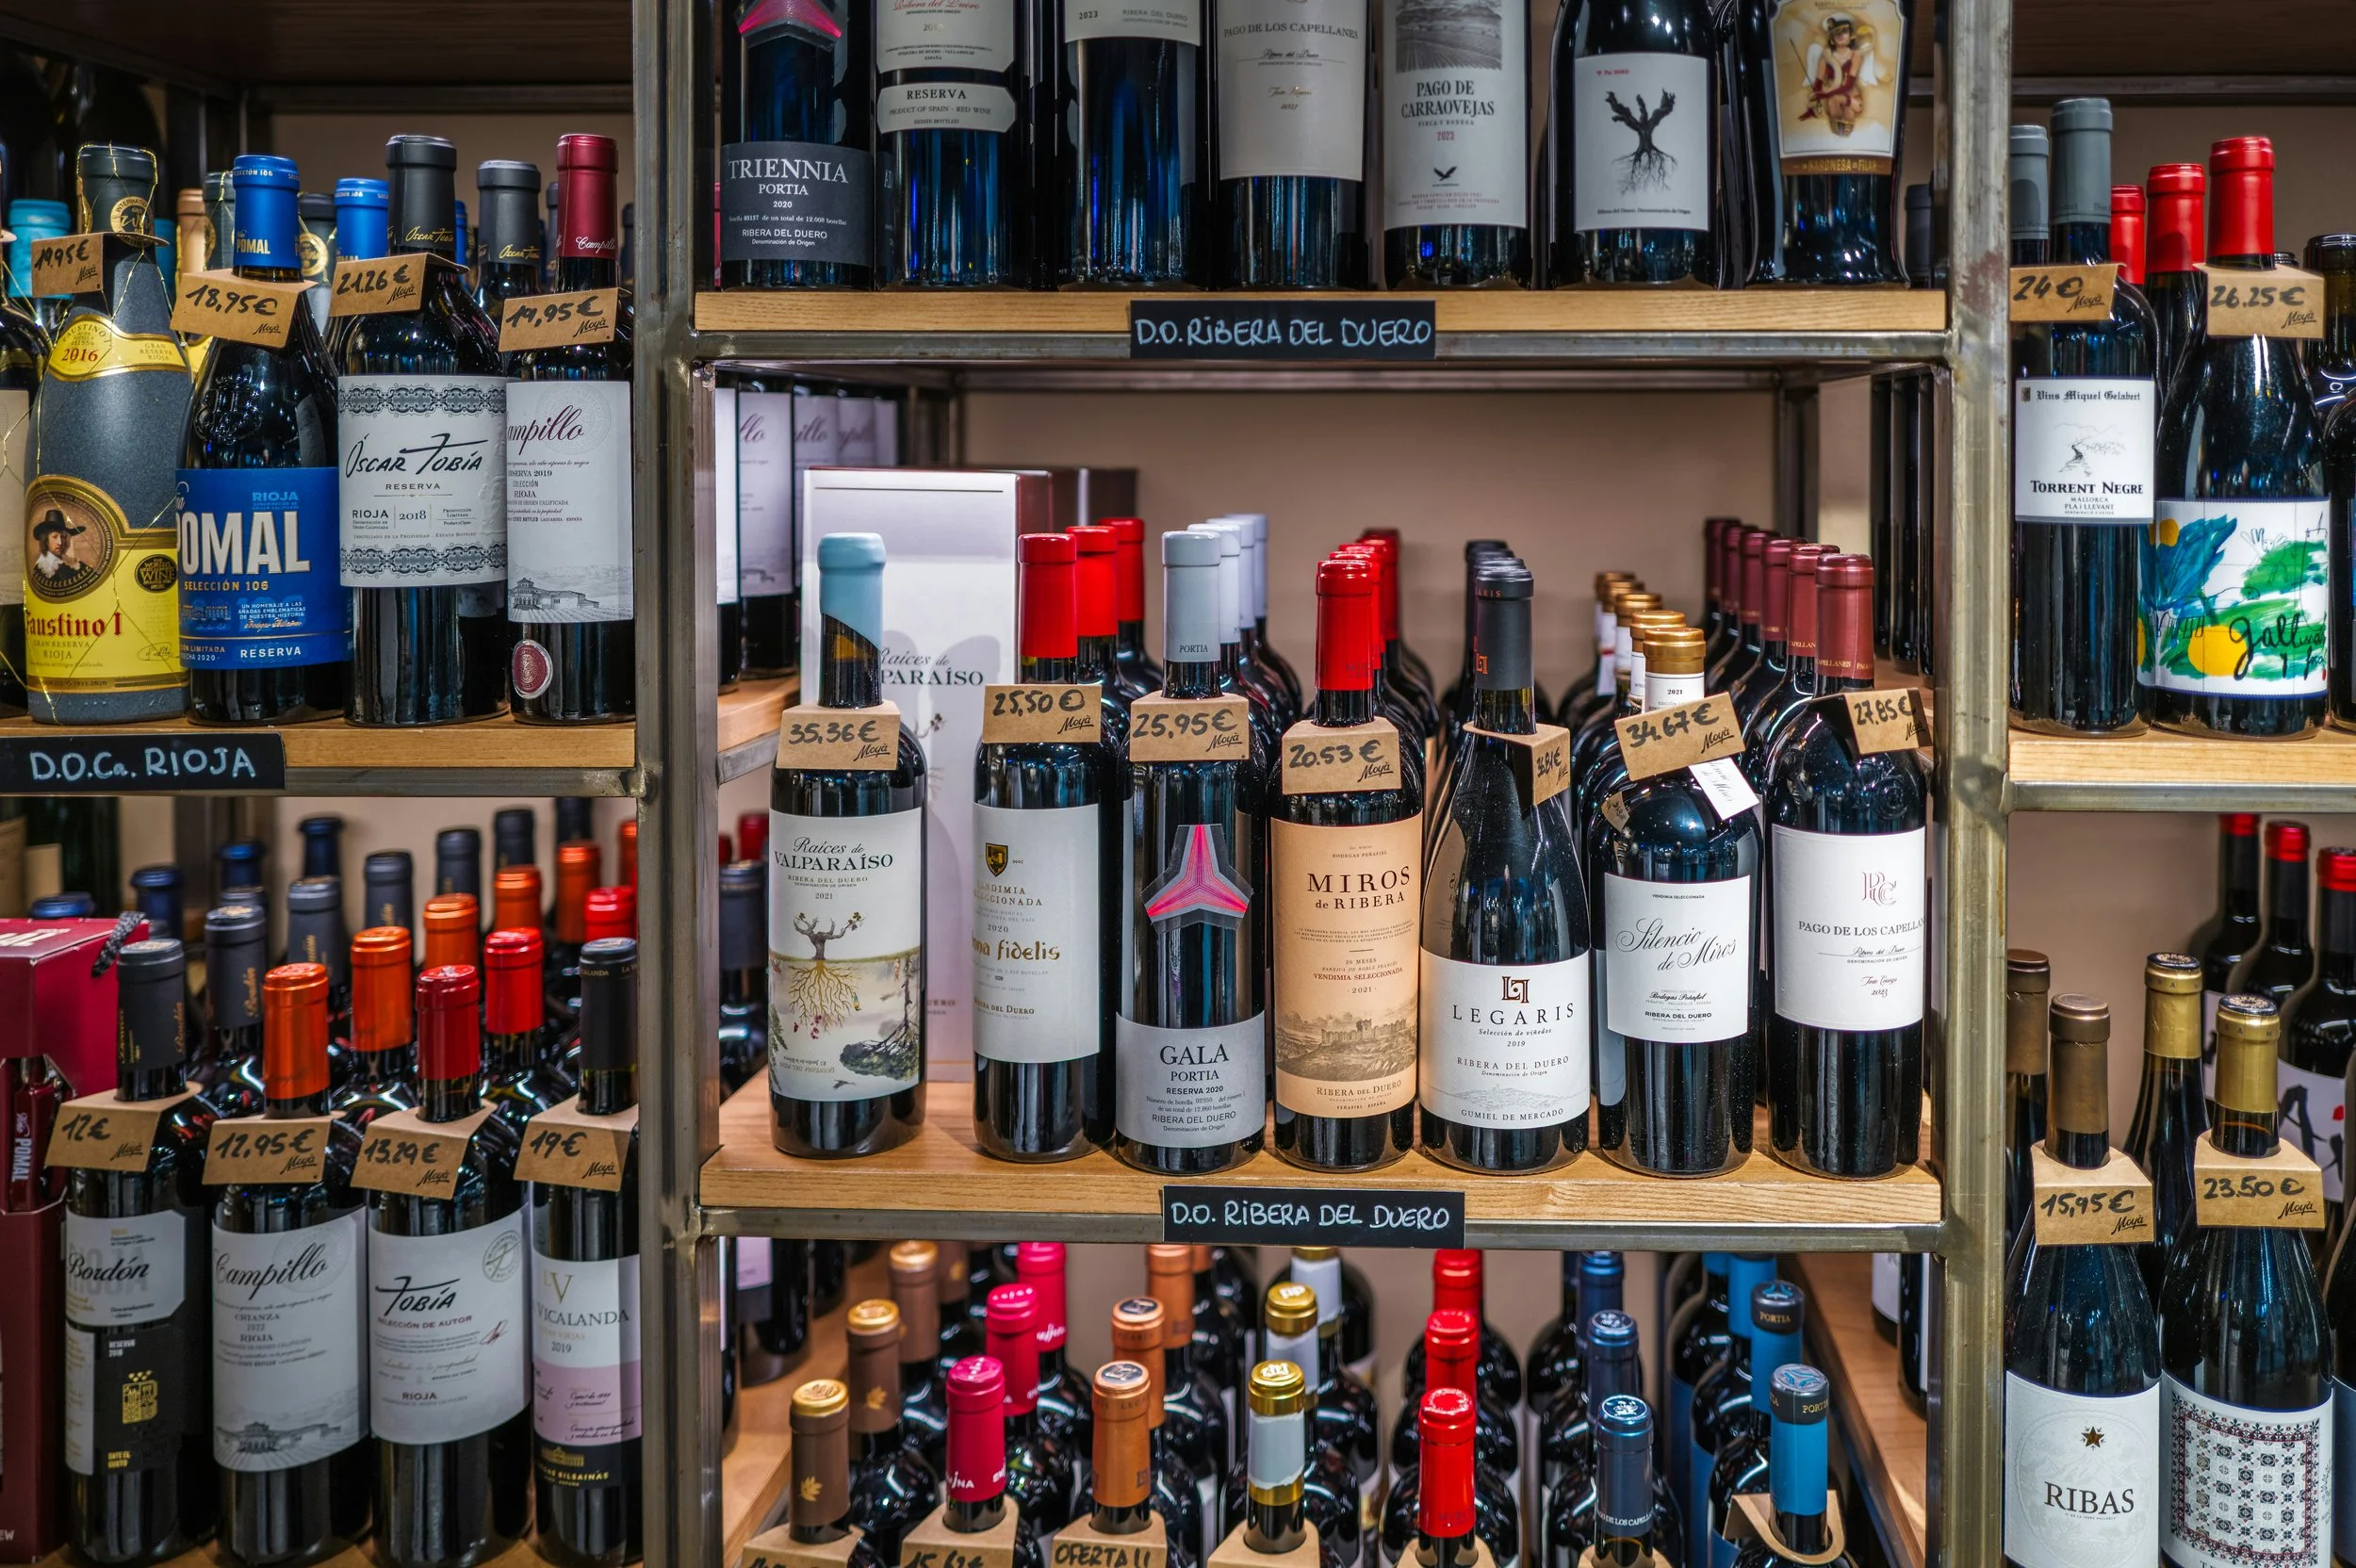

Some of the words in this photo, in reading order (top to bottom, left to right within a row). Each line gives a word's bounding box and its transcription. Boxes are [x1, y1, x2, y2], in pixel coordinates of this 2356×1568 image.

[1079, 10, 1099, 20] 2023
[1224, 25, 1245, 38] PAGO
[1248, 24, 1263, 33] DE
[1265, 23, 1286, 32] LOS
[1290, 23, 1358, 40] CAPELLANES
[907, 89, 967, 100] RESERVA
[1415, 81, 1452, 98] PAGO
[1455, 80, 1475, 95] DE
[889, 106, 915, 116] PRODUCT
[1401, 98, 1495, 120] CARRAOVEJAS
[728, 158, 849, 184] TRIENNIA
[759, 184, 810, 196] PORTIA
[794, 230, 827, 238] DUERO
[237, 239, 270, 255] POMAL
[1136, 318, 1183, 345] D.O.
[1289, 319, 1333, 345] DEL
[1341, 318, 1432, 347] DUERO
[61, 349, 99, 361] 2016
[2037, 391, 2060, 400] Vins
[2063, 390, 2101, 402] Miquel
[2104, 391, 2140, 400] Gelabert
[507, 404, 585, 455] ampillo
[2030, 481, 2096, 493] TORRENT
[2102, 482, 2143, 494] NEGRE
[252, 492, 299, 501] RIOJA
[352, 510, 388, 518] RIOJA
[400, 511, 426, 519] 2018
[185, 580, 239, 591] SELECCIÓN
[246, 581, 269, 591] 106
[43, 650, 73, 661] RIOJA
[190, 645, 225, 653] LIMITADA
[241, 646, 302, 659] RESERVA
[1179, 644, 1208, 653] PORTIA
[145, 746, 256, 778] RIOJA
[794, 836, 847, 856] Raíces
[851, 842, 865, 854] de
[774, 851, 893, 872] VALPARAÍSO
[788, 874, 814, 883] RIBERA
[1307, 865, 1410, 893] MIROS
[1316, 900, 1329, 908] de
[1333, 891, 1404, 909] RIBERA
[987, 923, 1009, 933] 2020
[1615, 917, 1706, 953] Silencio
[1799, 921, 1830, 935] PAGO
[1834, 926, 1851, 936] DE
[1855, 926, 1877, 937] LOS
[997, 939, 1060, 961] fidelis
[1658, 952, 1675, 972] de
[1677, 936, 1737, 969] Miros
[1313, 972, 1351, 982] VENDIMIA
[1354, 967, 1403, 981] SELECCIONADA
[1649, 992, 1677, 1001] Bodegas
[1678, 992, 1706, 1001] Peñafiel
[1006, 1005, 1035, 1014] DUERO
[1453, 1003, 1574, 1025] LEGARIS
[1479, 1028, 1513, 1037] Selección
[1159, 1043, 1230, 1067] GALA
[1458, 1057, 1498, 1070] RIBERA
[1506, 1062, 1528, 1070] DEL
[1535, 1056, 1569, 1069] DUERO
[1170, 1070, 1219, 1082] PORTIA
[1317, 1086, 1354, 1097] RIBERA
[1372, 1079, 1402, 1093] DUERO
[1153, 1114, 1184, 1124] RIBERA
[1207, 1111, 1236, 1122] DUERO
[1462, 1109, 1497, 1120] GUMIEL
[1520, 1108, 1563, 1120] MERCADO
[12, 1138, 33, 1183] POMAL
[1170, 1202, 1217, 1225] D.O.
[1319, 1204, 1363, 1227] DEL
[1369, 1205, 1450, 1231] DUERO
[67, 1246, 150, 1282] Bordón
[215, 1241, 328, 1300] Campillo
[536, 1301, 630, 1327] VICALANDA
[1759, 1311, 1792, 1323] PORTIA
[377, 1316, 420, 1330] SELECCIÓN
[422, 1319, 436, 1329] DE
[438, 1315, 472, 1328] AUTOR
[551, 1341, 572, 1353] 2019
[401, 1392, 437, 1401] RIOJA
[2044, 1480, 2135, 1515] RIBAS
